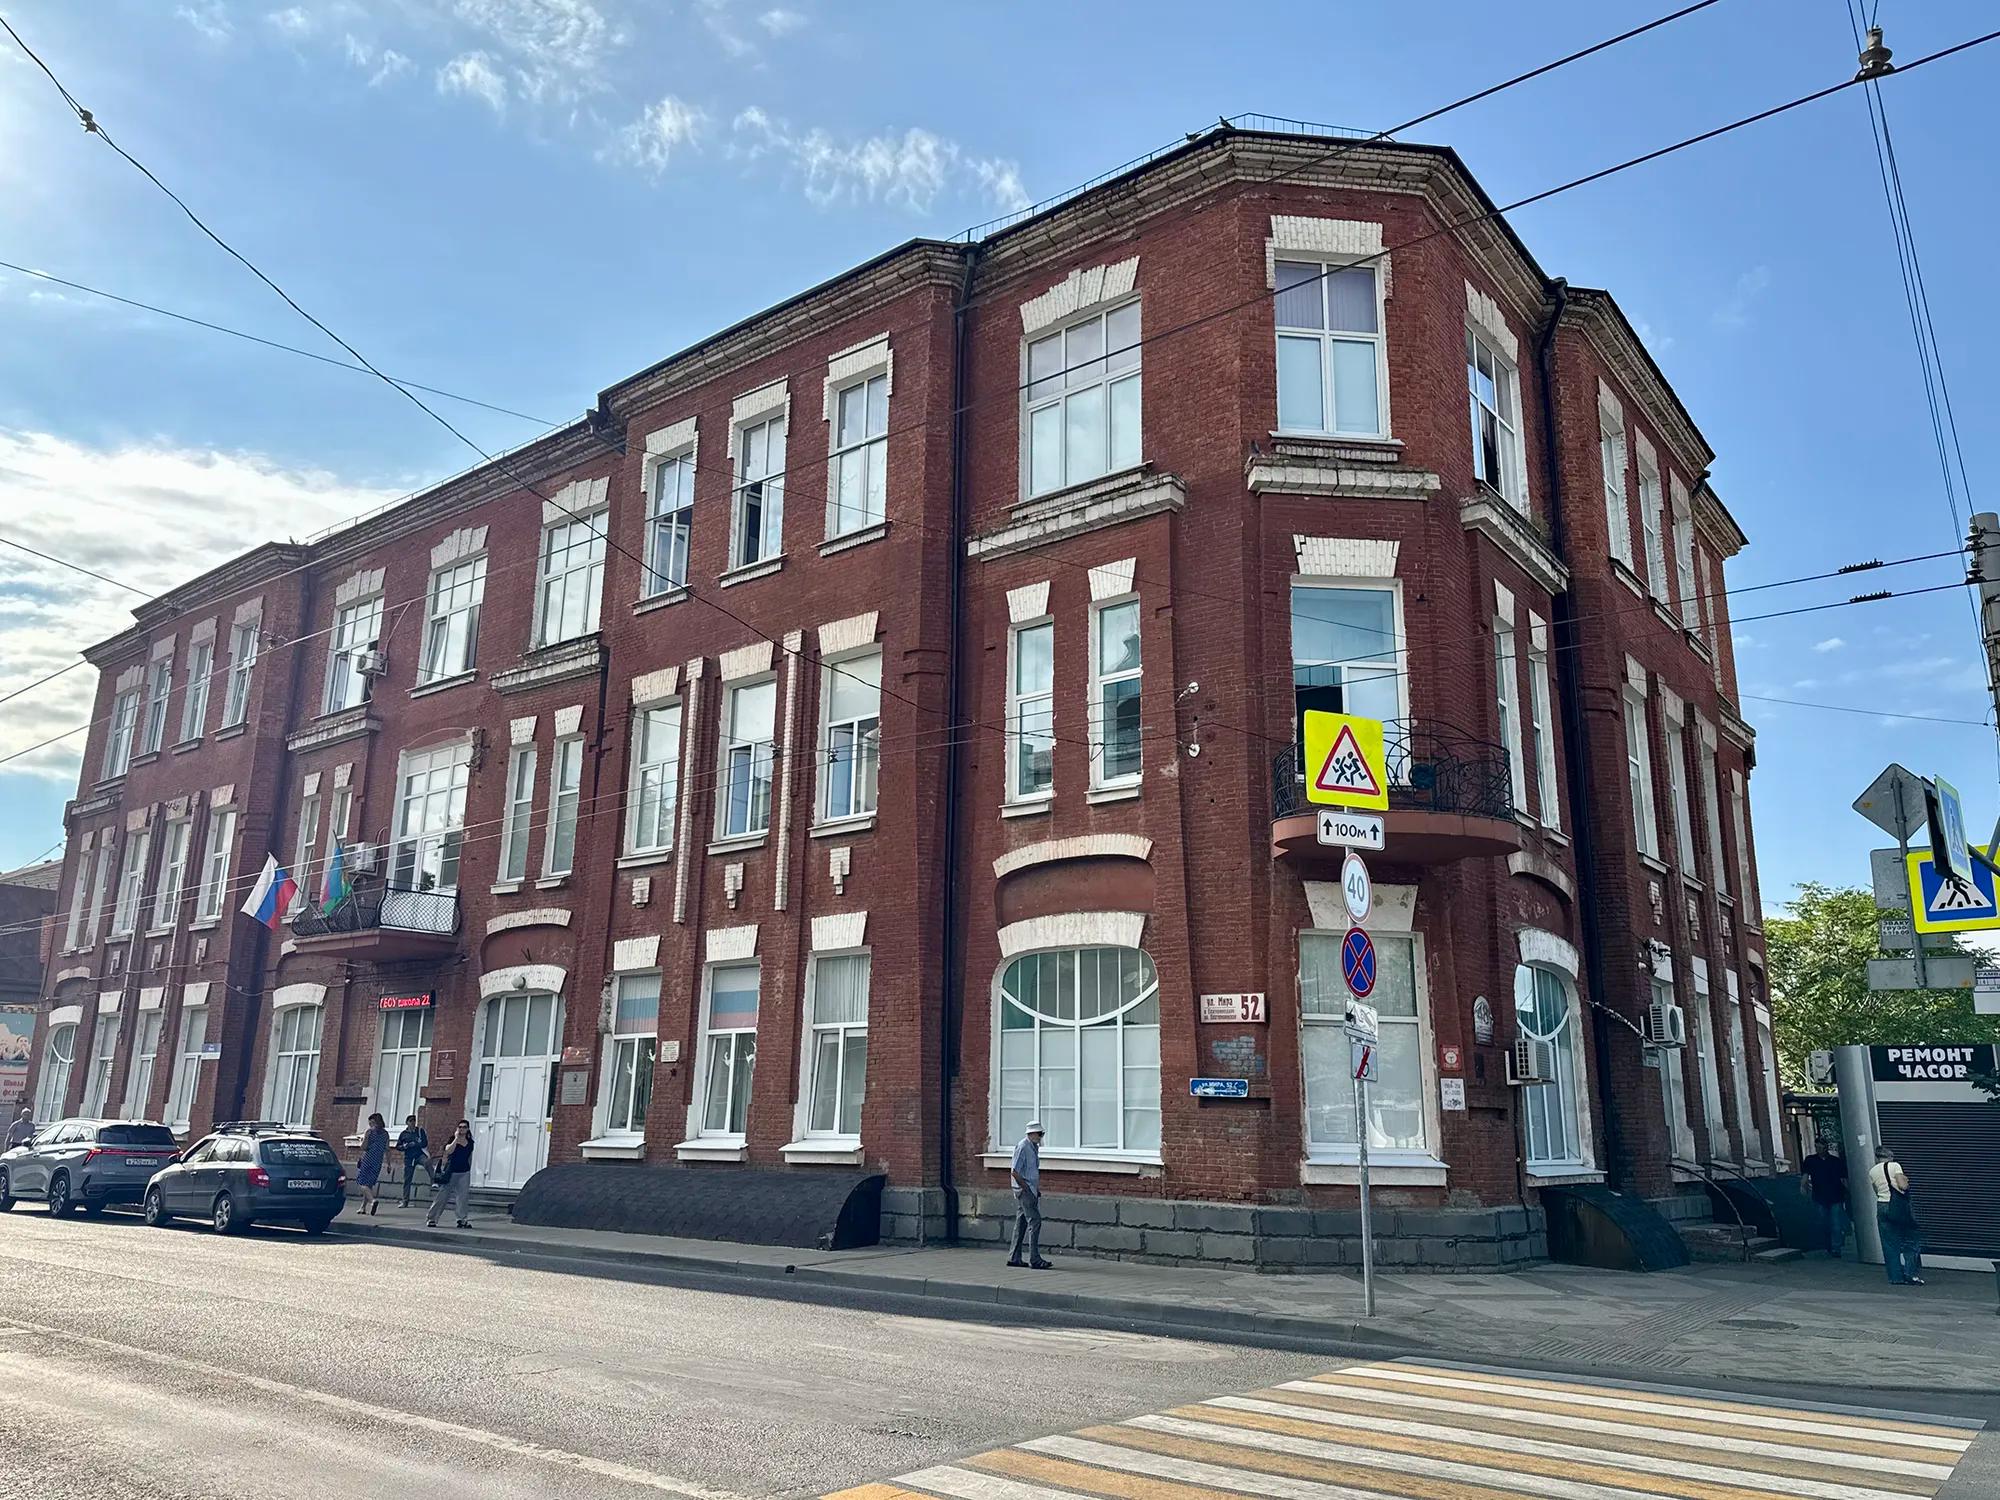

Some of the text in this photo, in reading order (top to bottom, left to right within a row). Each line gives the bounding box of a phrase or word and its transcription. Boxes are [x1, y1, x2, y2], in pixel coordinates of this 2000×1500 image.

[1334, 823, 1367, 839] 100м
[1347, 873, 1365, 902] 40
[1206, 998, 1215, 1007] ул.
[1217, 996, 1233, 1007] Мира
[1241, 995, 1260, 1020] 52
[1887, 1048, 1974, 1062] РЕМОНТ
[1898, 1064, 1968, 1078] ЧАСОВ
